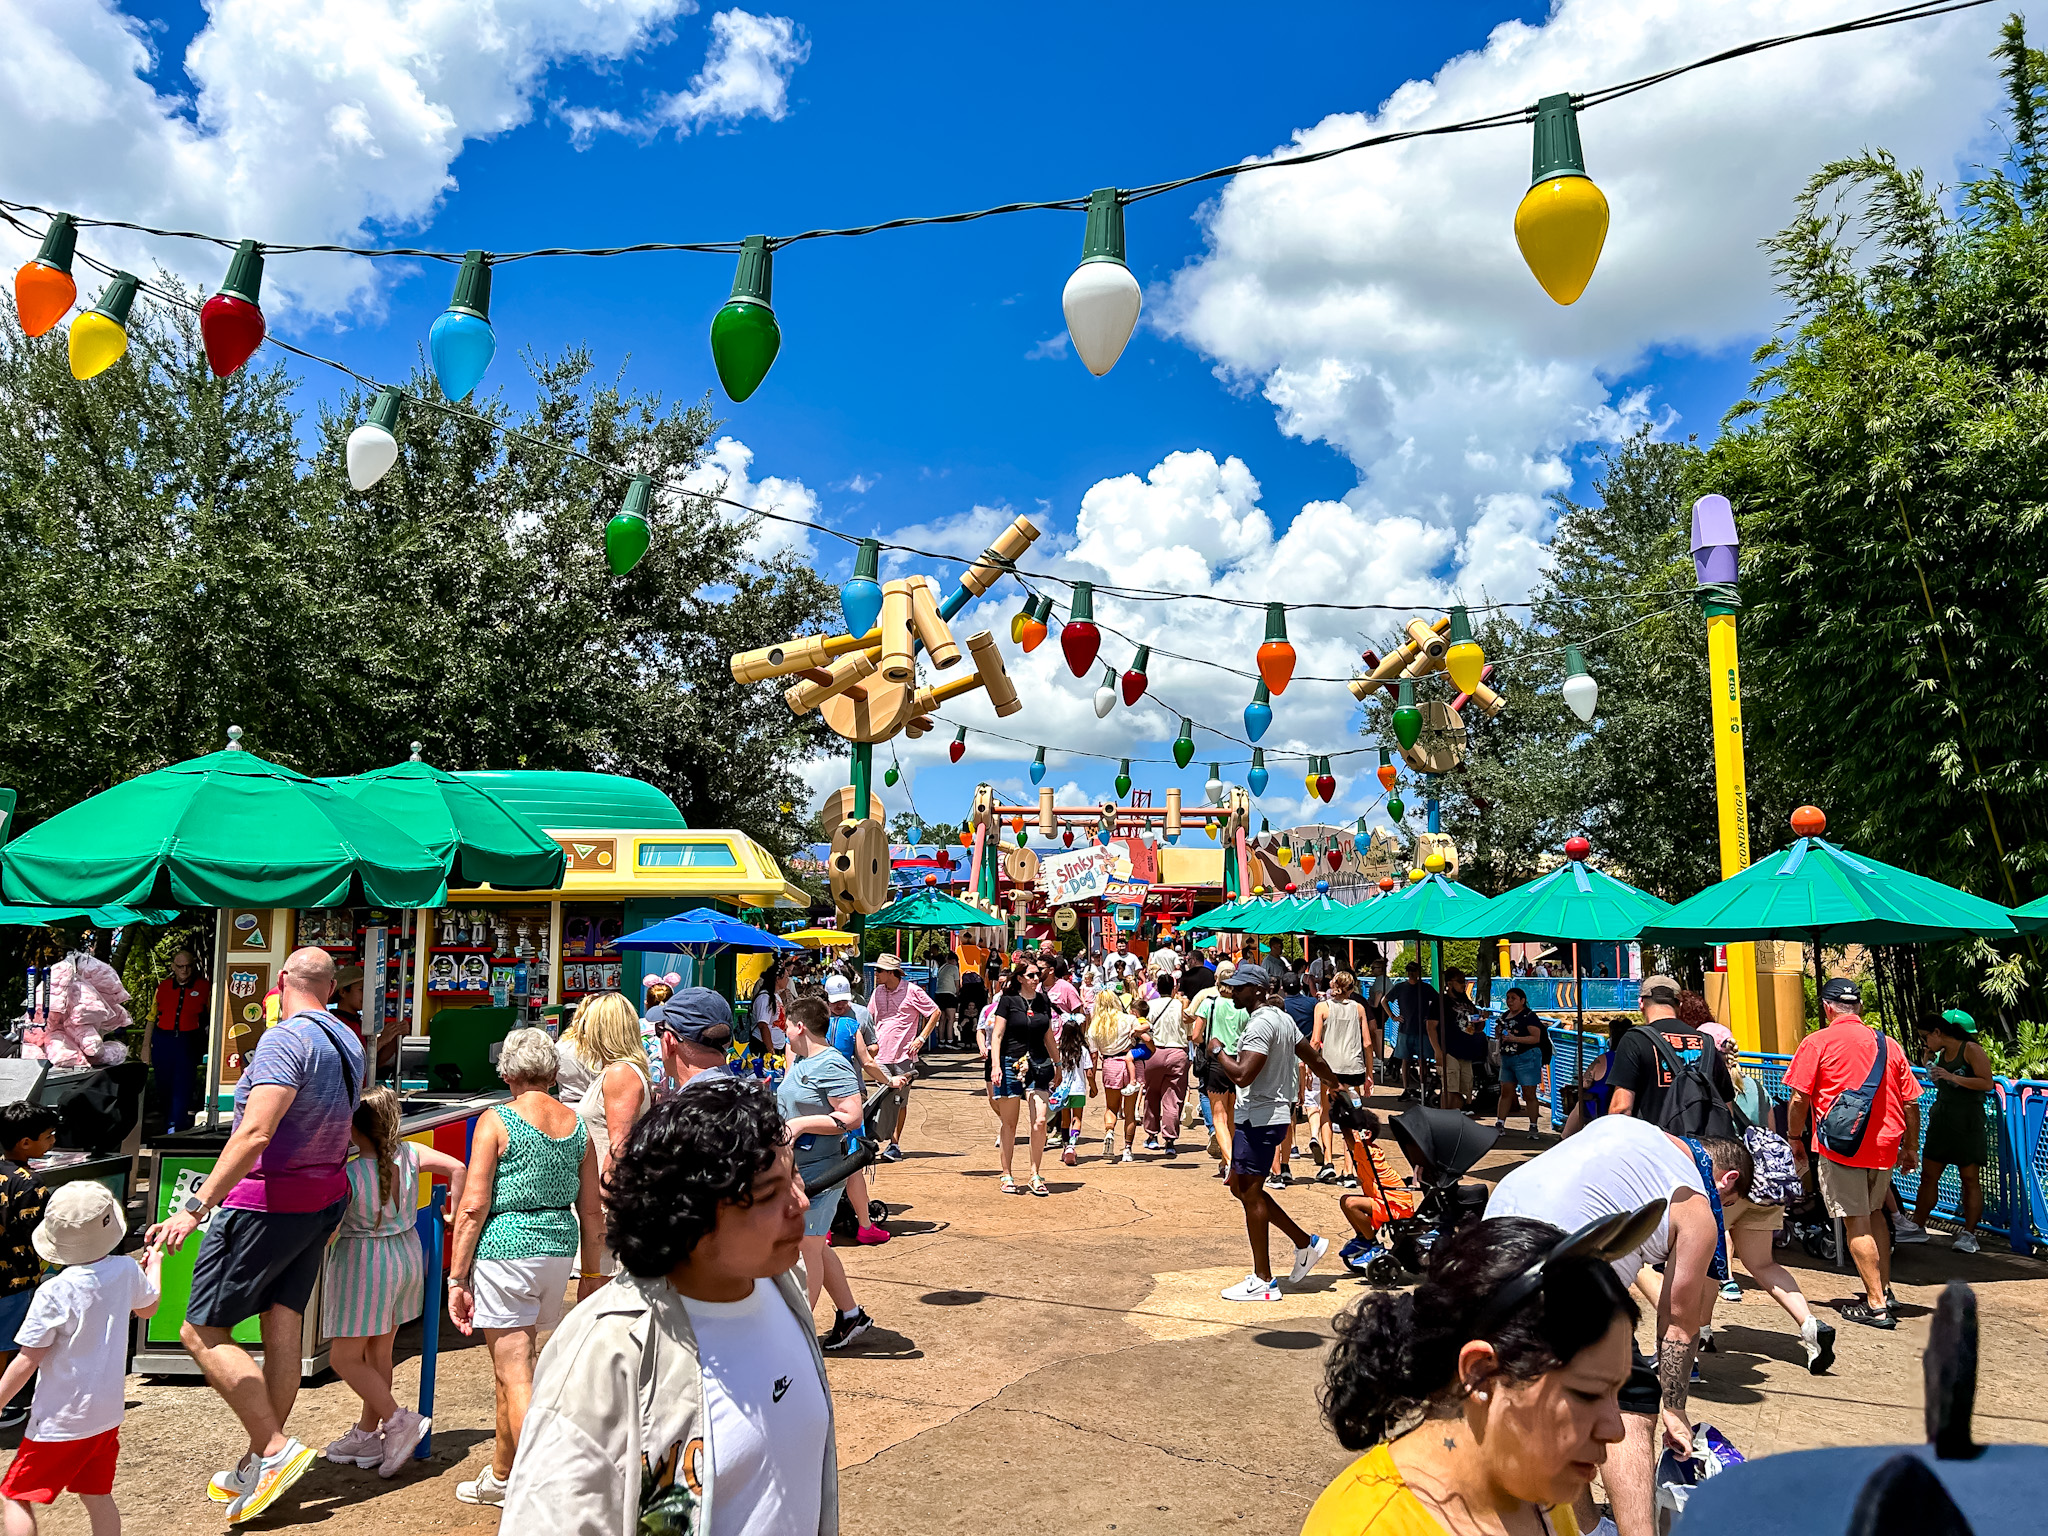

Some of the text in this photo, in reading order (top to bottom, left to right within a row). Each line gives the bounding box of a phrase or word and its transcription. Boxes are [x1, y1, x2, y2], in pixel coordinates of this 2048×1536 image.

[1728, 674, 1736, 697] SOFT
[1056, 854, 1094, 884] Slinky
[1068, 870, 1097, 895] Dog
[1105, 882, 1147, 896] DASH
[27, 974, 35, 1008] BUD LIGHT
